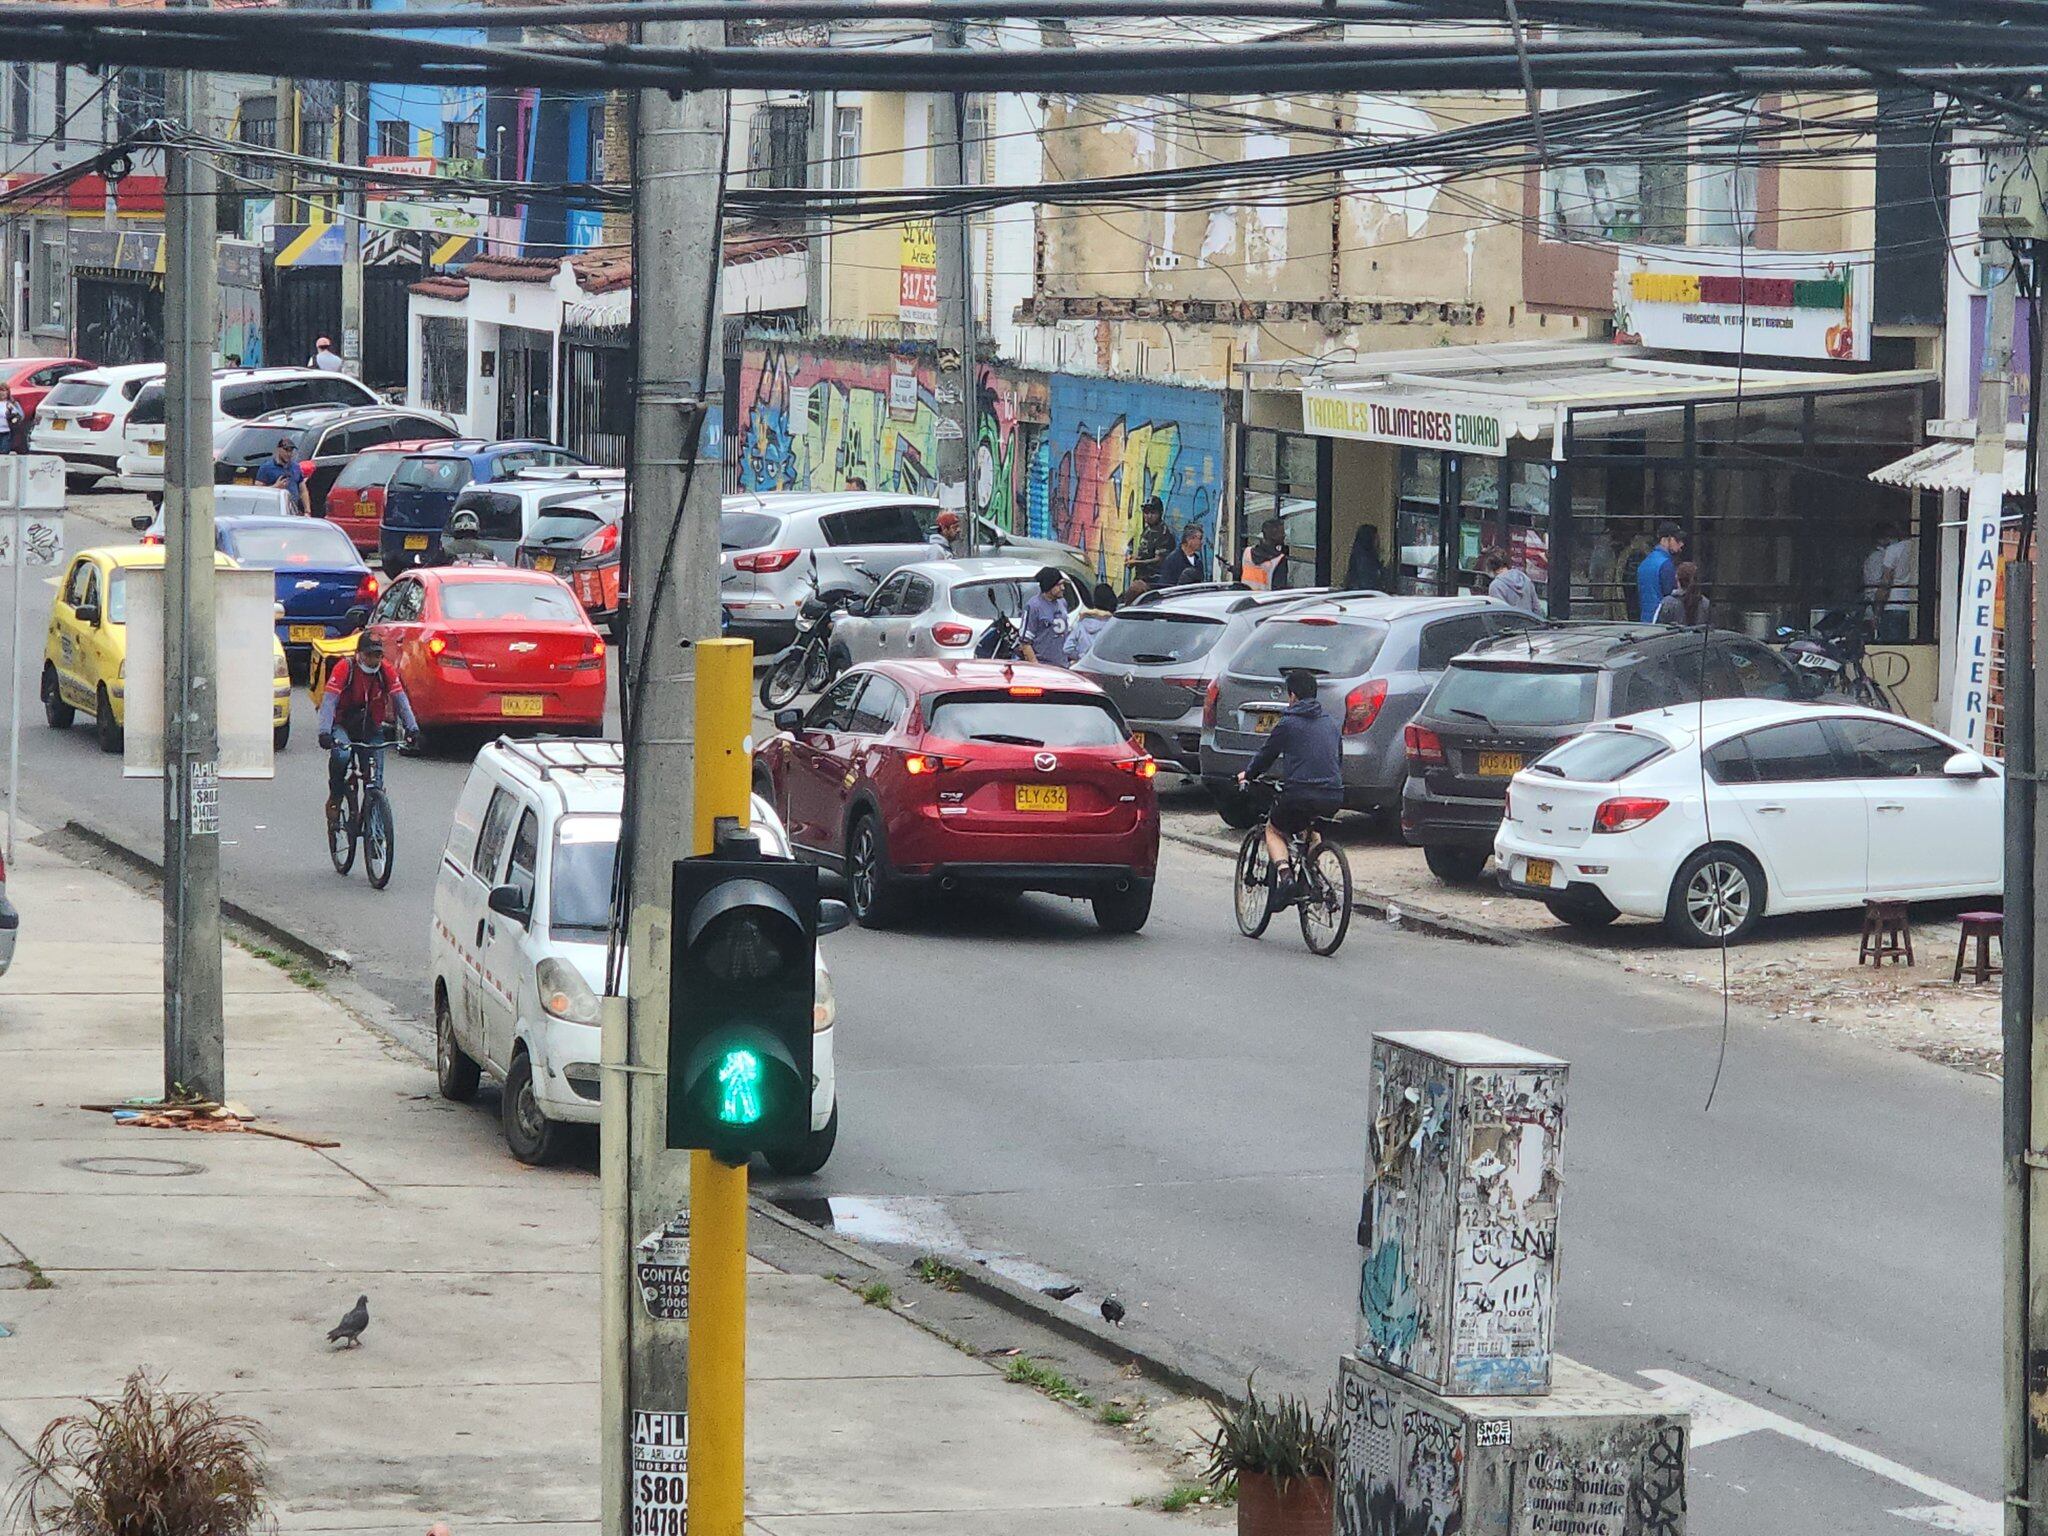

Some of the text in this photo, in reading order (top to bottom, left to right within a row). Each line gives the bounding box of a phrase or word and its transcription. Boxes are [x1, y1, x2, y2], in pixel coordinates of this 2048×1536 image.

[902, 273, 921, 301] 317
[1308, 397, 1501, 448] TAMALES TOLIMENSES EDUARD
[1967, 523, 1995, 749] PAPELERI
[1018, 788, 1065, 804] ELY 636
[635, 1461, 687, 1472] INDEPEN
